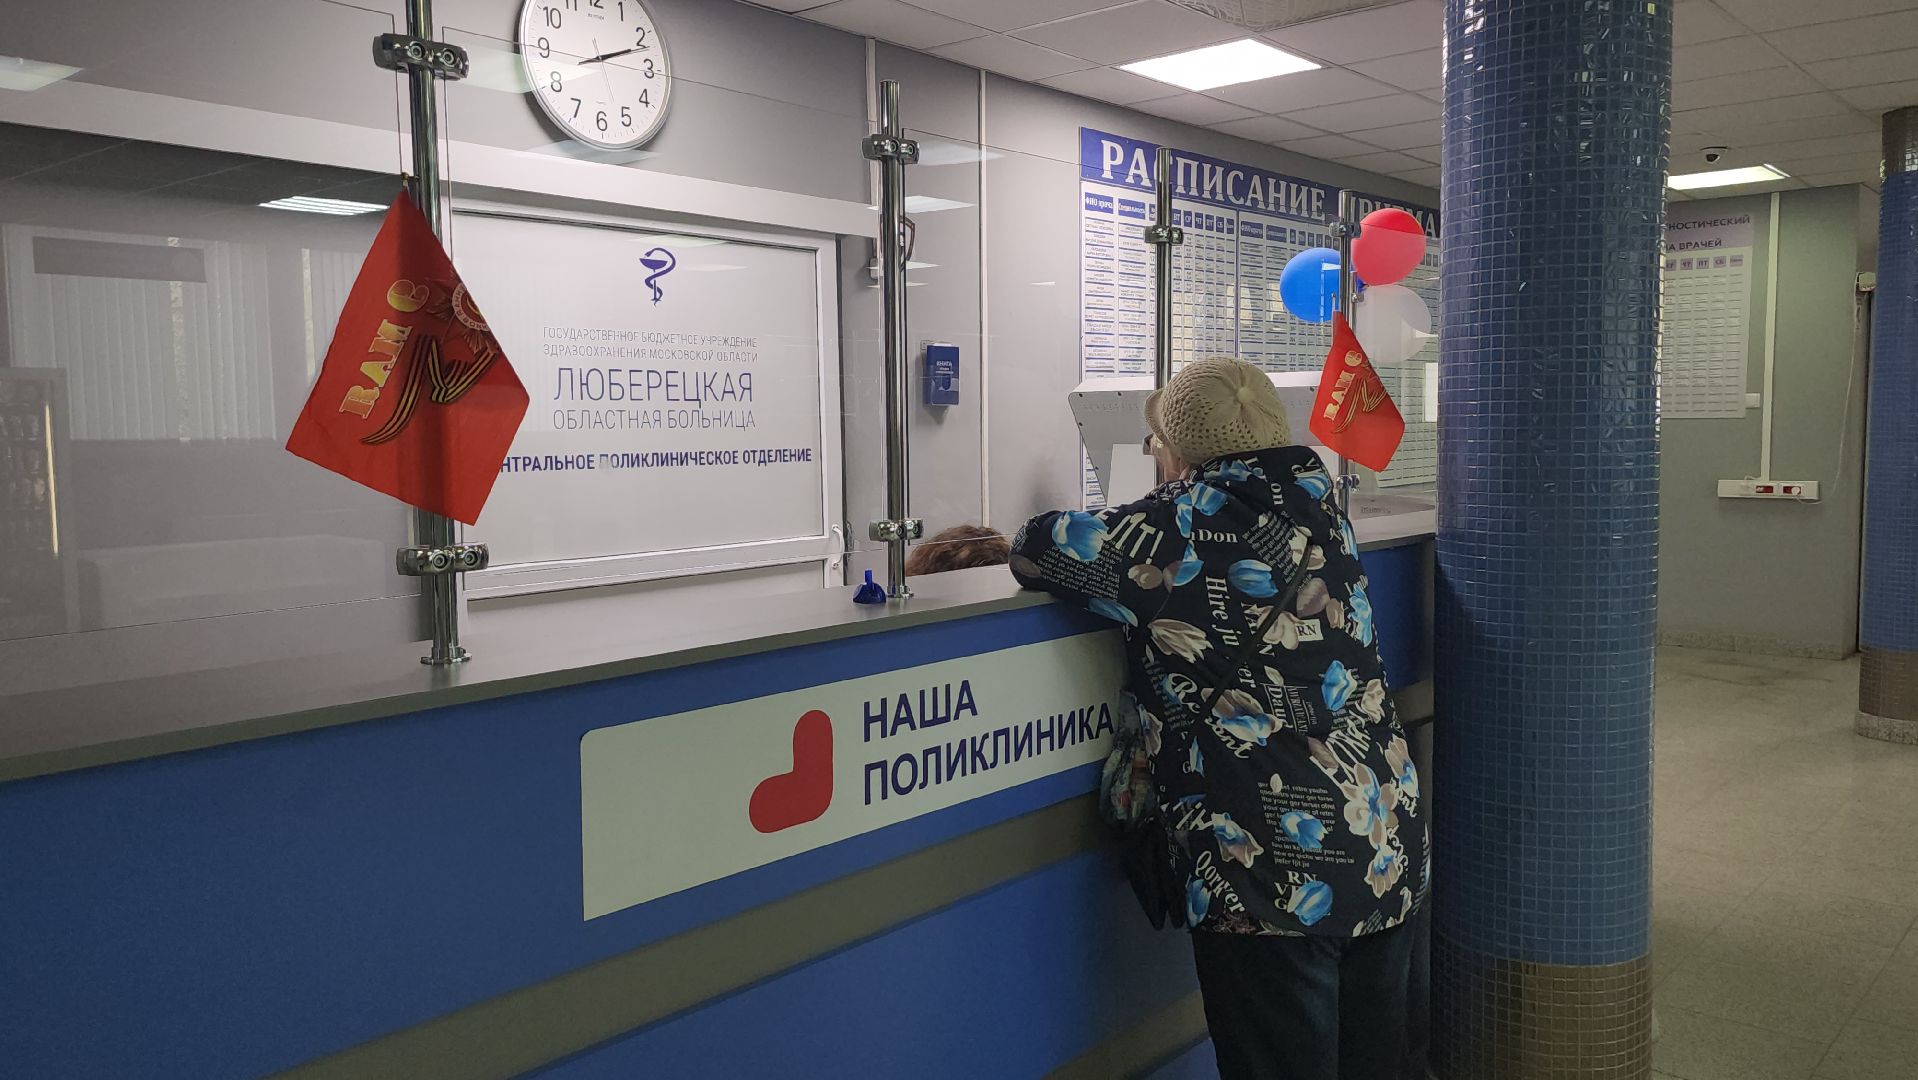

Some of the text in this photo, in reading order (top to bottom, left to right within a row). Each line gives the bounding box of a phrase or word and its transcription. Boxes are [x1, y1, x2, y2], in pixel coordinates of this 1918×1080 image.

[543, 6, 562, 29] 10
[617, 1, 625, 22] 1
[537, 37, 550, 59] 9
[635, 26, 647, 49] 2
[643, 58, 655, 79] 3
[550, 71, 563, 93] 8
[570, 97, 582, 119] 7
[638, 88, 651, 108] 4
[596, 111, 608, 132] 6
[620, 106, 632, 127] 5
[1101, 139, 1326, 221] РАПИСАНИЕ
[1666, 214, 1751, 231] НОСТИЧЕСКИЙ
[1679, 237, 1722, 250] ВРАЧЕЙ
[543, 326, 758, 348] ГОСУДАРСТВЕННОЕ БЮДЖЕТНОЕ УЧРЕЖДЕНИЕ
[543, 343, 758, 363] ЗДРАВООХРАНЕНИЯ МОСКОВСКОЙ ОБЛАСТИ
[554, 367, 753, 409] ЛЮБЕРЕЦКАЯ
[553, 409, 756, 432] ОБЛАСТНАЯ БОЛЬНИЦА
[500, 448, 812, 473] НТРАЛЬНОЕ ПОЛИКЛИНИЧЕСКОЕ ОТДЕЛЕНИЕ
[1205, 576, 1232, 621] Hire
[863, 679, 979, 743] НАША
[864, 702, 1115, 806] ПОЛИКЛИНИКА
